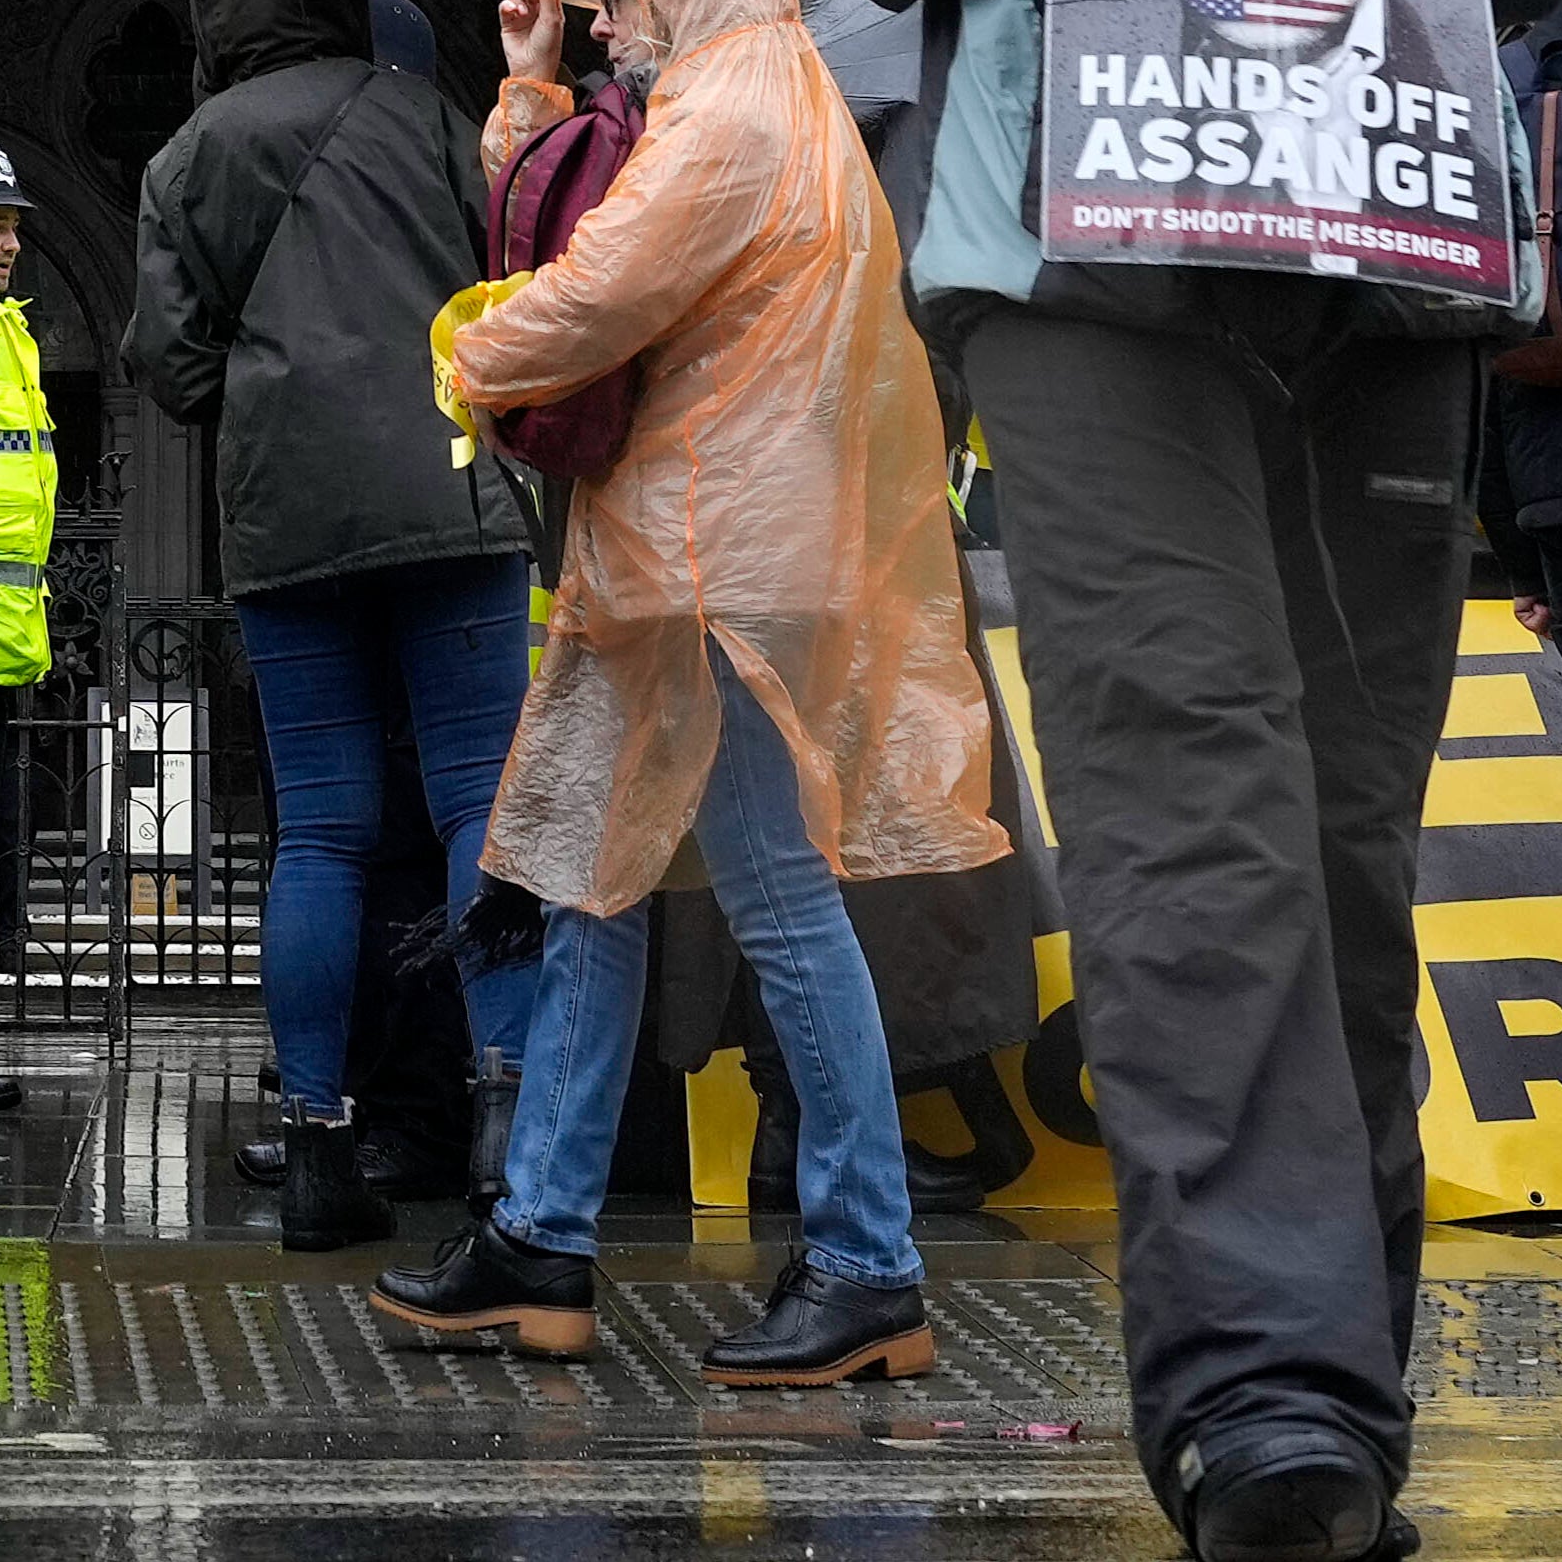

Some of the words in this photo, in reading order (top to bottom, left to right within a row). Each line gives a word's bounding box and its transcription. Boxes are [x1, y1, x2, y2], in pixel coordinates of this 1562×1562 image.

[1078, 53, 1331, 120] HANDS
[1348, 79, 1474, 144] OFF
[1074, 117, 1479, 220] ASSANGE
[1073, 206, 1162, 229] DON'T
[1163, 207, 1263, 236] SHOOT
[1263, 212, 1314, 241] THE
[1318, 219, 1481, 269] MESSENGER
